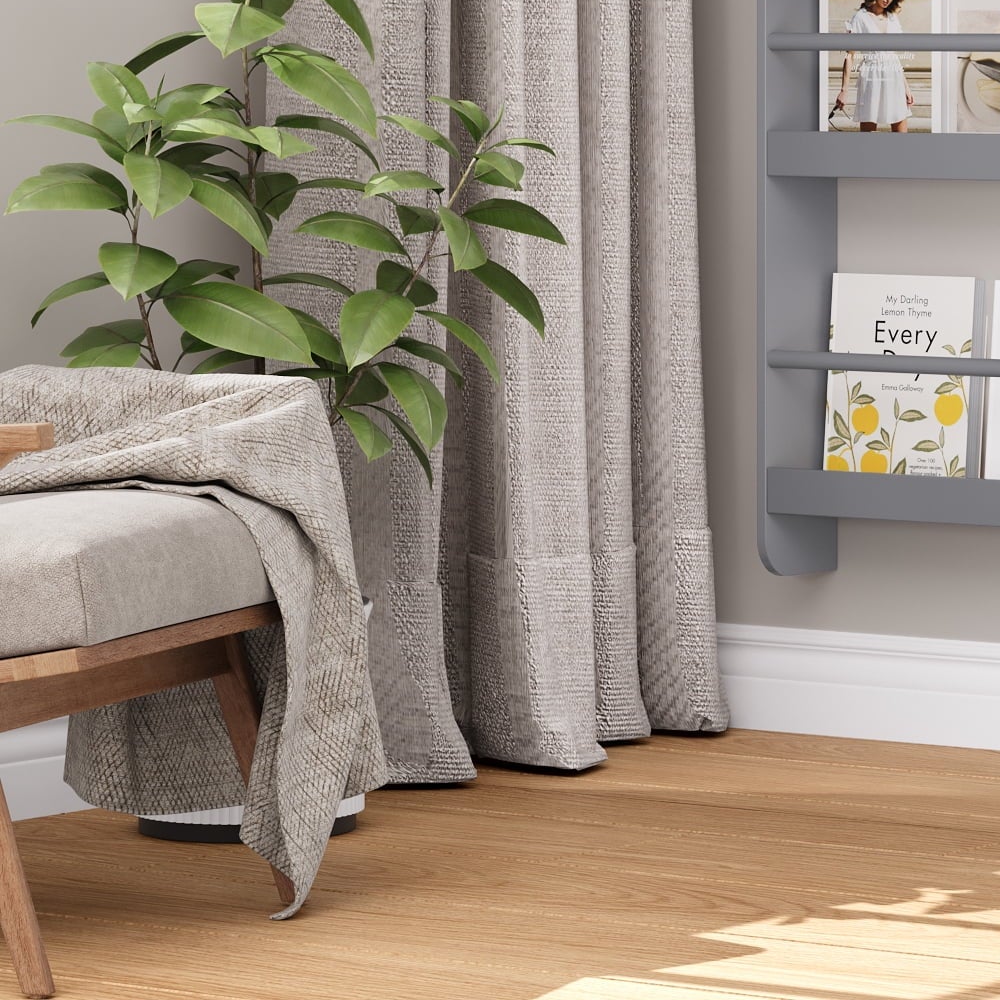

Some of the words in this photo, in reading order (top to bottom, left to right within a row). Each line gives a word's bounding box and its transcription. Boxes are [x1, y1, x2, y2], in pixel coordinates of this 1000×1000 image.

[885, 295, 897, 305] My
[900, 294, 929, 307] Darling
[881, 307, 905, 316] Lemon
[908, 307, 932, 319] Thyme
[874, 320, 938, 353] Every
[881, 383, 898, 391] Emma
[899, 384, 924, 393] Galloway
